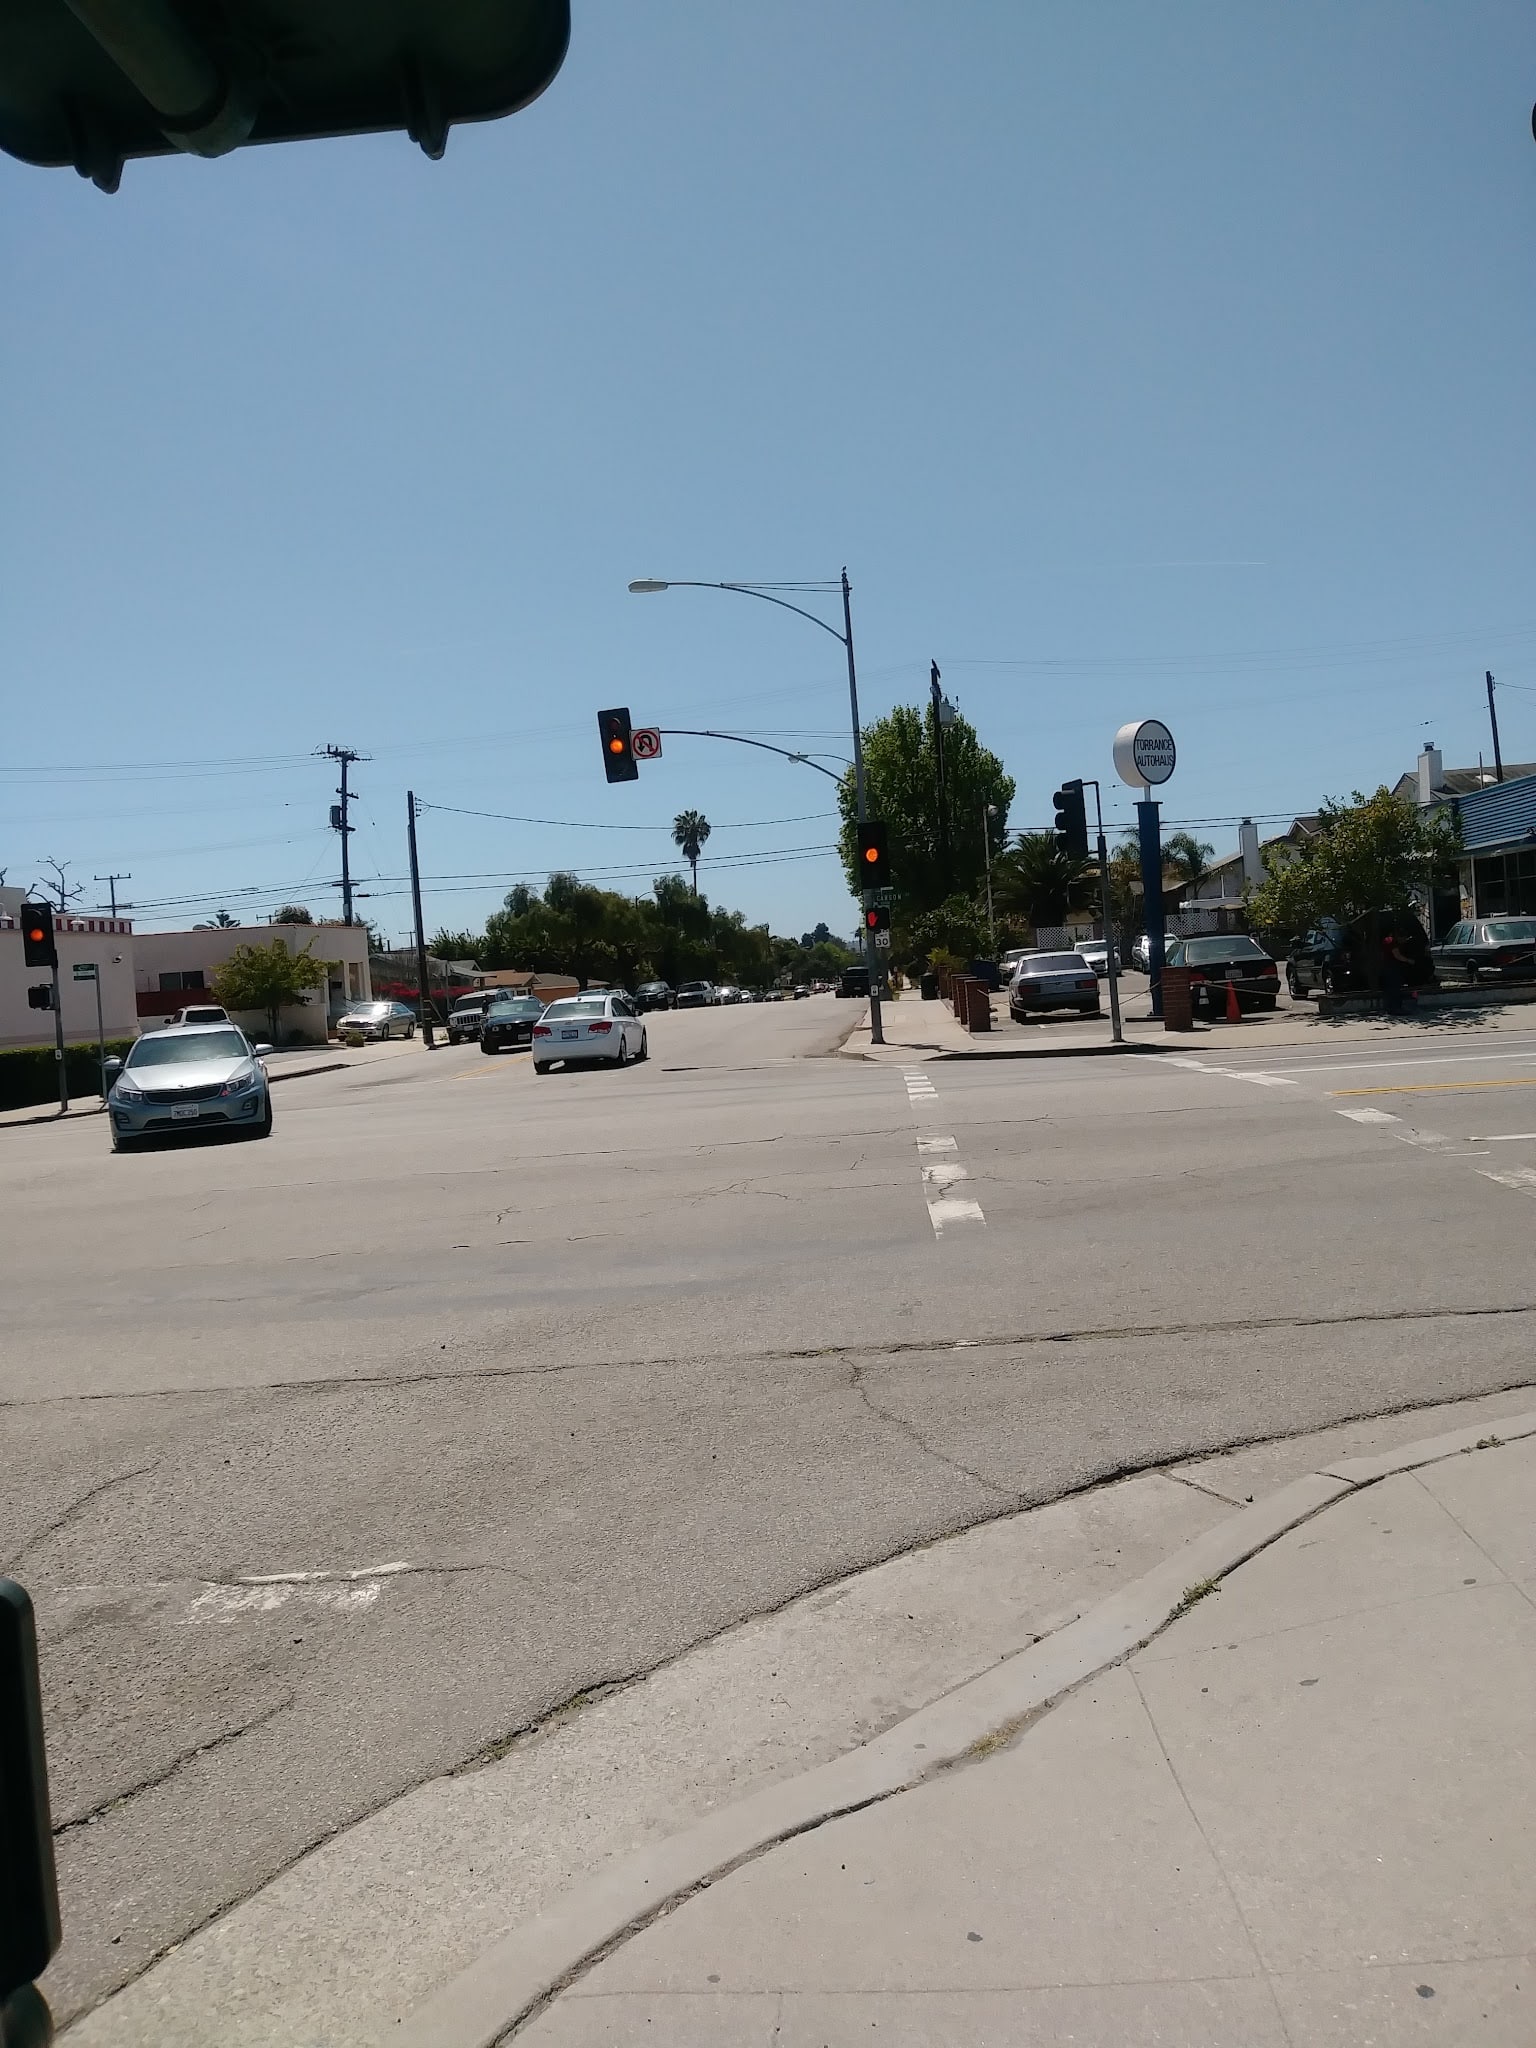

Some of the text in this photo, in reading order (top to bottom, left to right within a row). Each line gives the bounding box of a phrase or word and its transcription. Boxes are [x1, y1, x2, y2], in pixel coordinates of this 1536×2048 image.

[1136, 739, 1173, 751] TORRANCE
[1137, 754, 1175, 767] AUTOHAUS
[876, 938, 888, 946] 30
